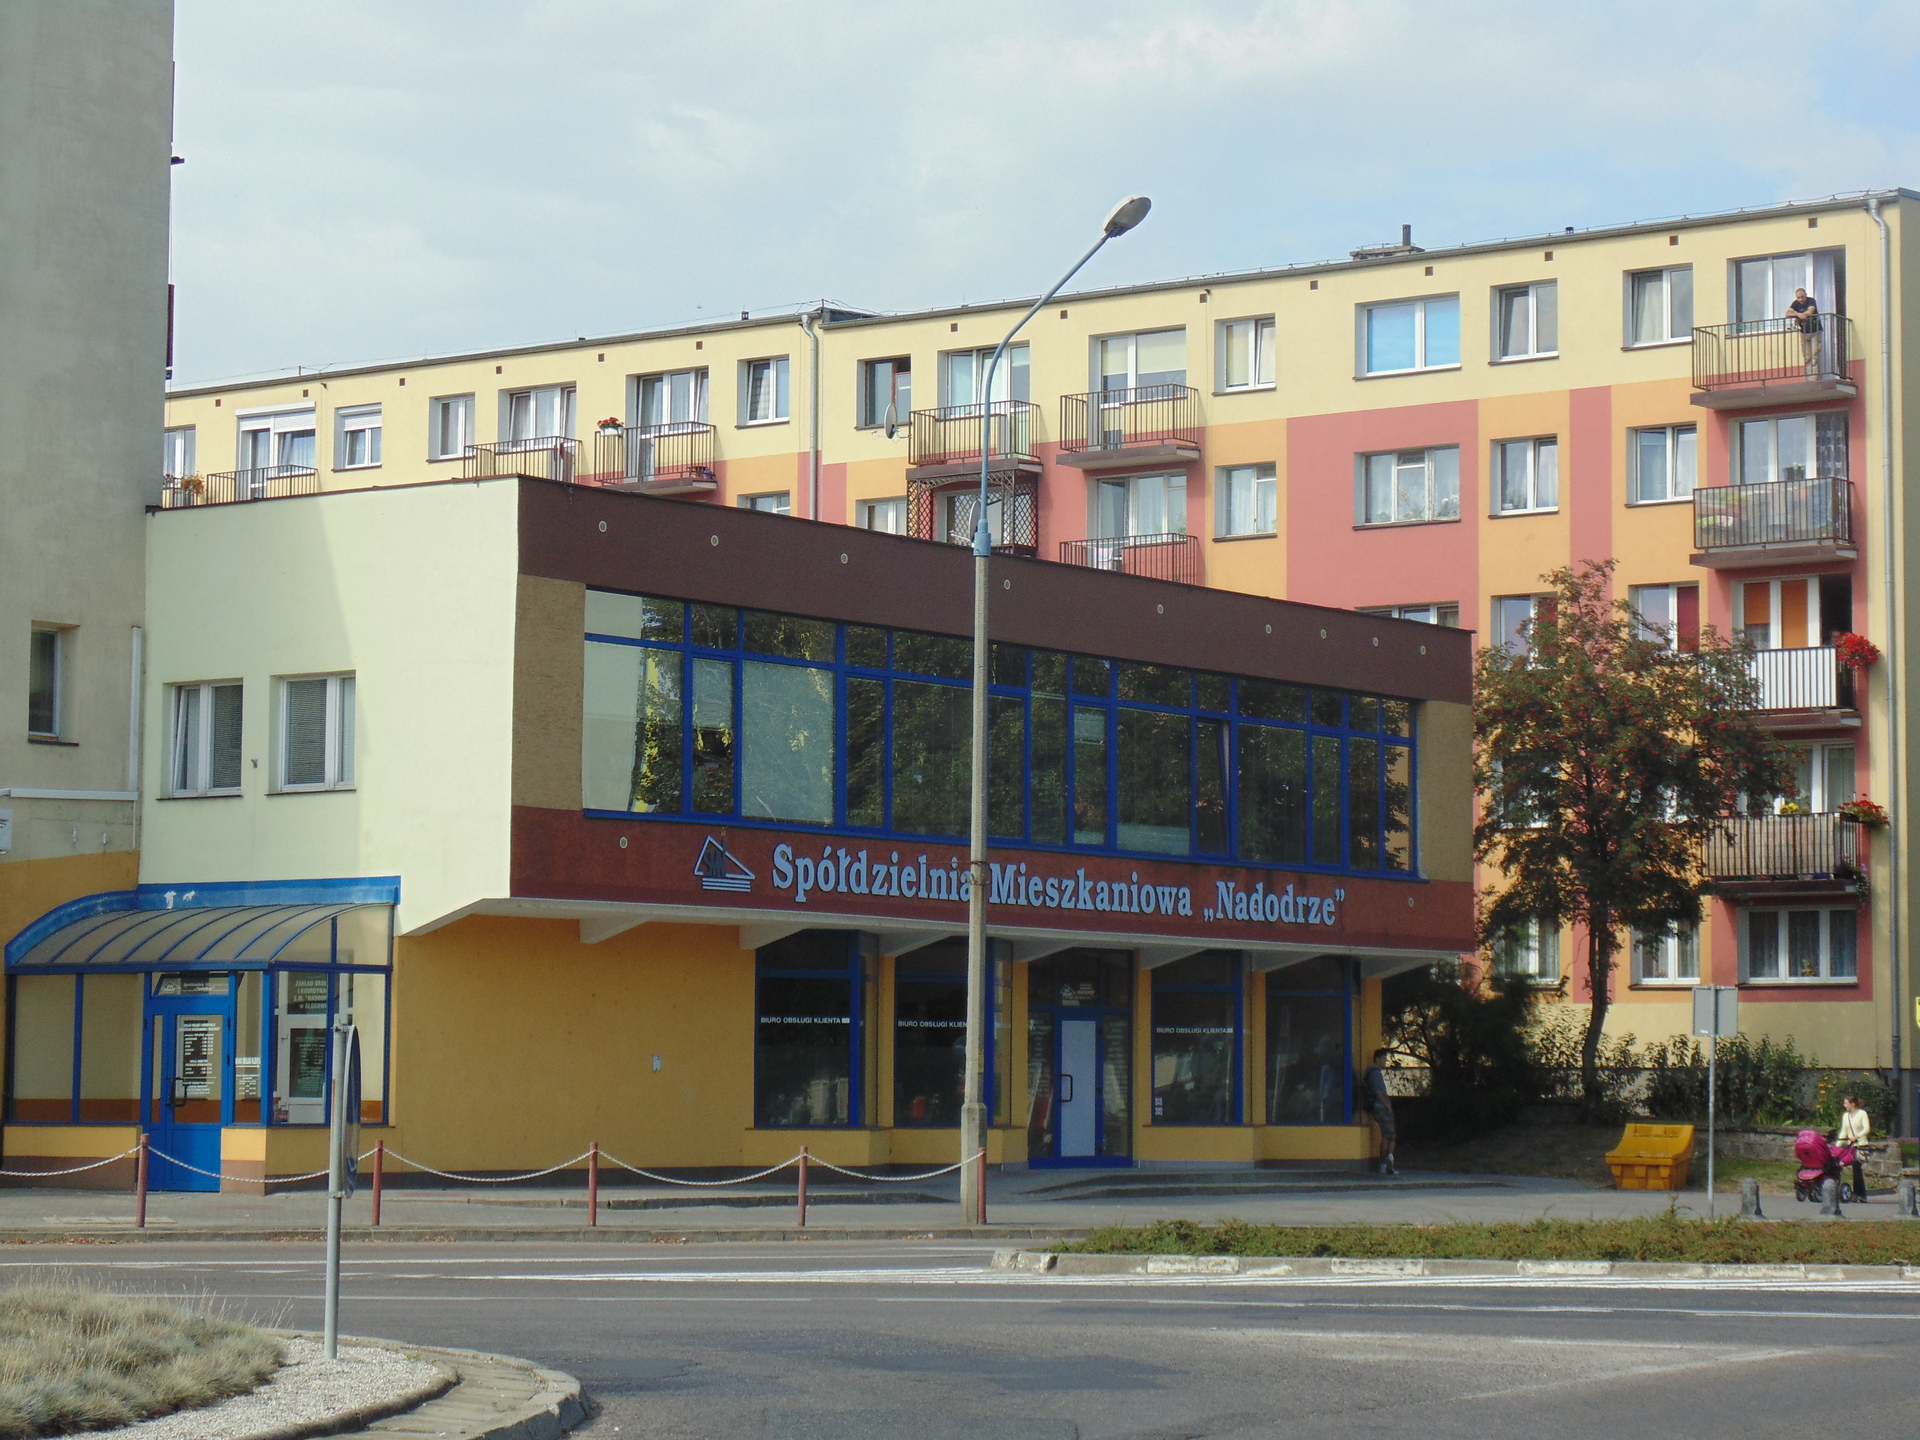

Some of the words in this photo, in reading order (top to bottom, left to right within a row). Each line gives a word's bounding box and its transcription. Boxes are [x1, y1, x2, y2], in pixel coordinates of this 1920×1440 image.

[773, 843, 971, 903] Spółdzielnia
[989, 863, 1193, 917] Mieszkaniowa
[1203, 881, 1345, 926] „Nadodrze”
[783, 1016, 812, 1024] OBSŁUGI
[919, 1020, 948, 1028] OBSŁUGI
